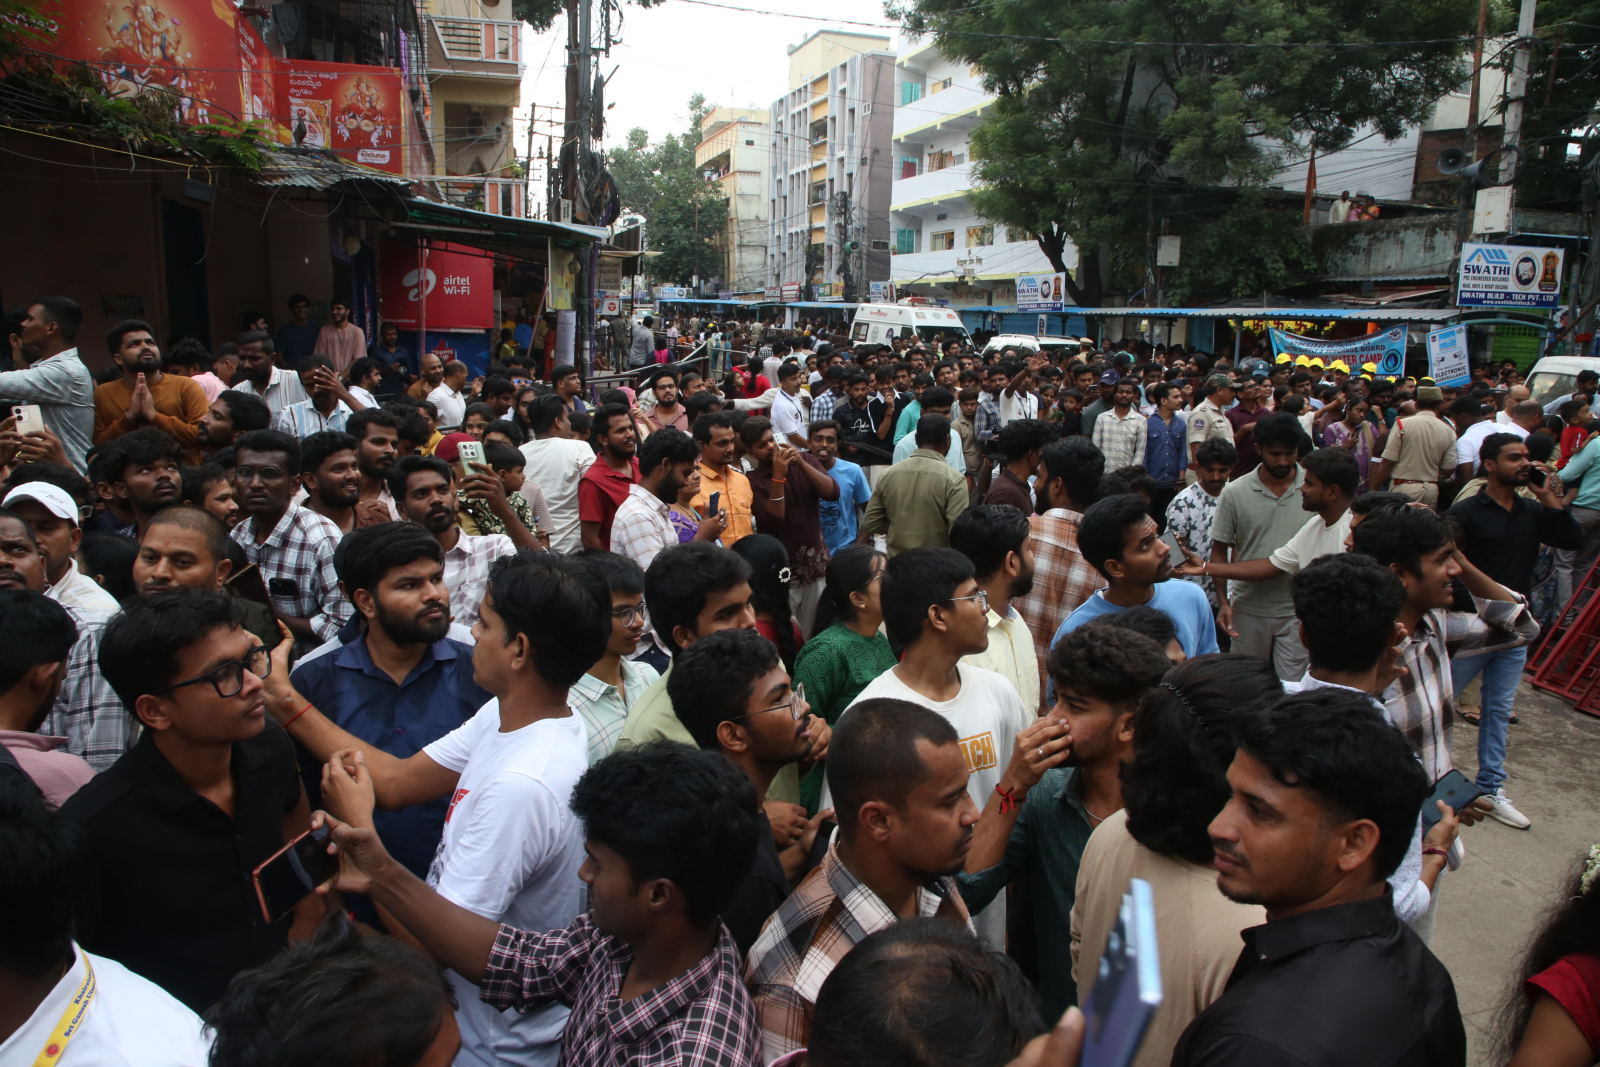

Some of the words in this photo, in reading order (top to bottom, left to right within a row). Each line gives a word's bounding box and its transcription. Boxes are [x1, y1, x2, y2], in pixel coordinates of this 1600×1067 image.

[1463, 264, 1511, 276] SWATHI
[443, 275, 470, 286] airtel
[443, 285, 470, 296] Wi-Fi
[1461, 291, 1486, 299] SWATHI
[1486, 292, 1505, 300] BUILD
[1512, 293, 1526, 301] TECH
[1360, 344, 1386, 352] BOARD
[1359, 353, 1383, 365] CAMP
[1434, 365, 1466, 379] ELECTRONIC
[64, 1025, 75, 1037] Sri
[72, 999, 90, 1024] Ganesh
